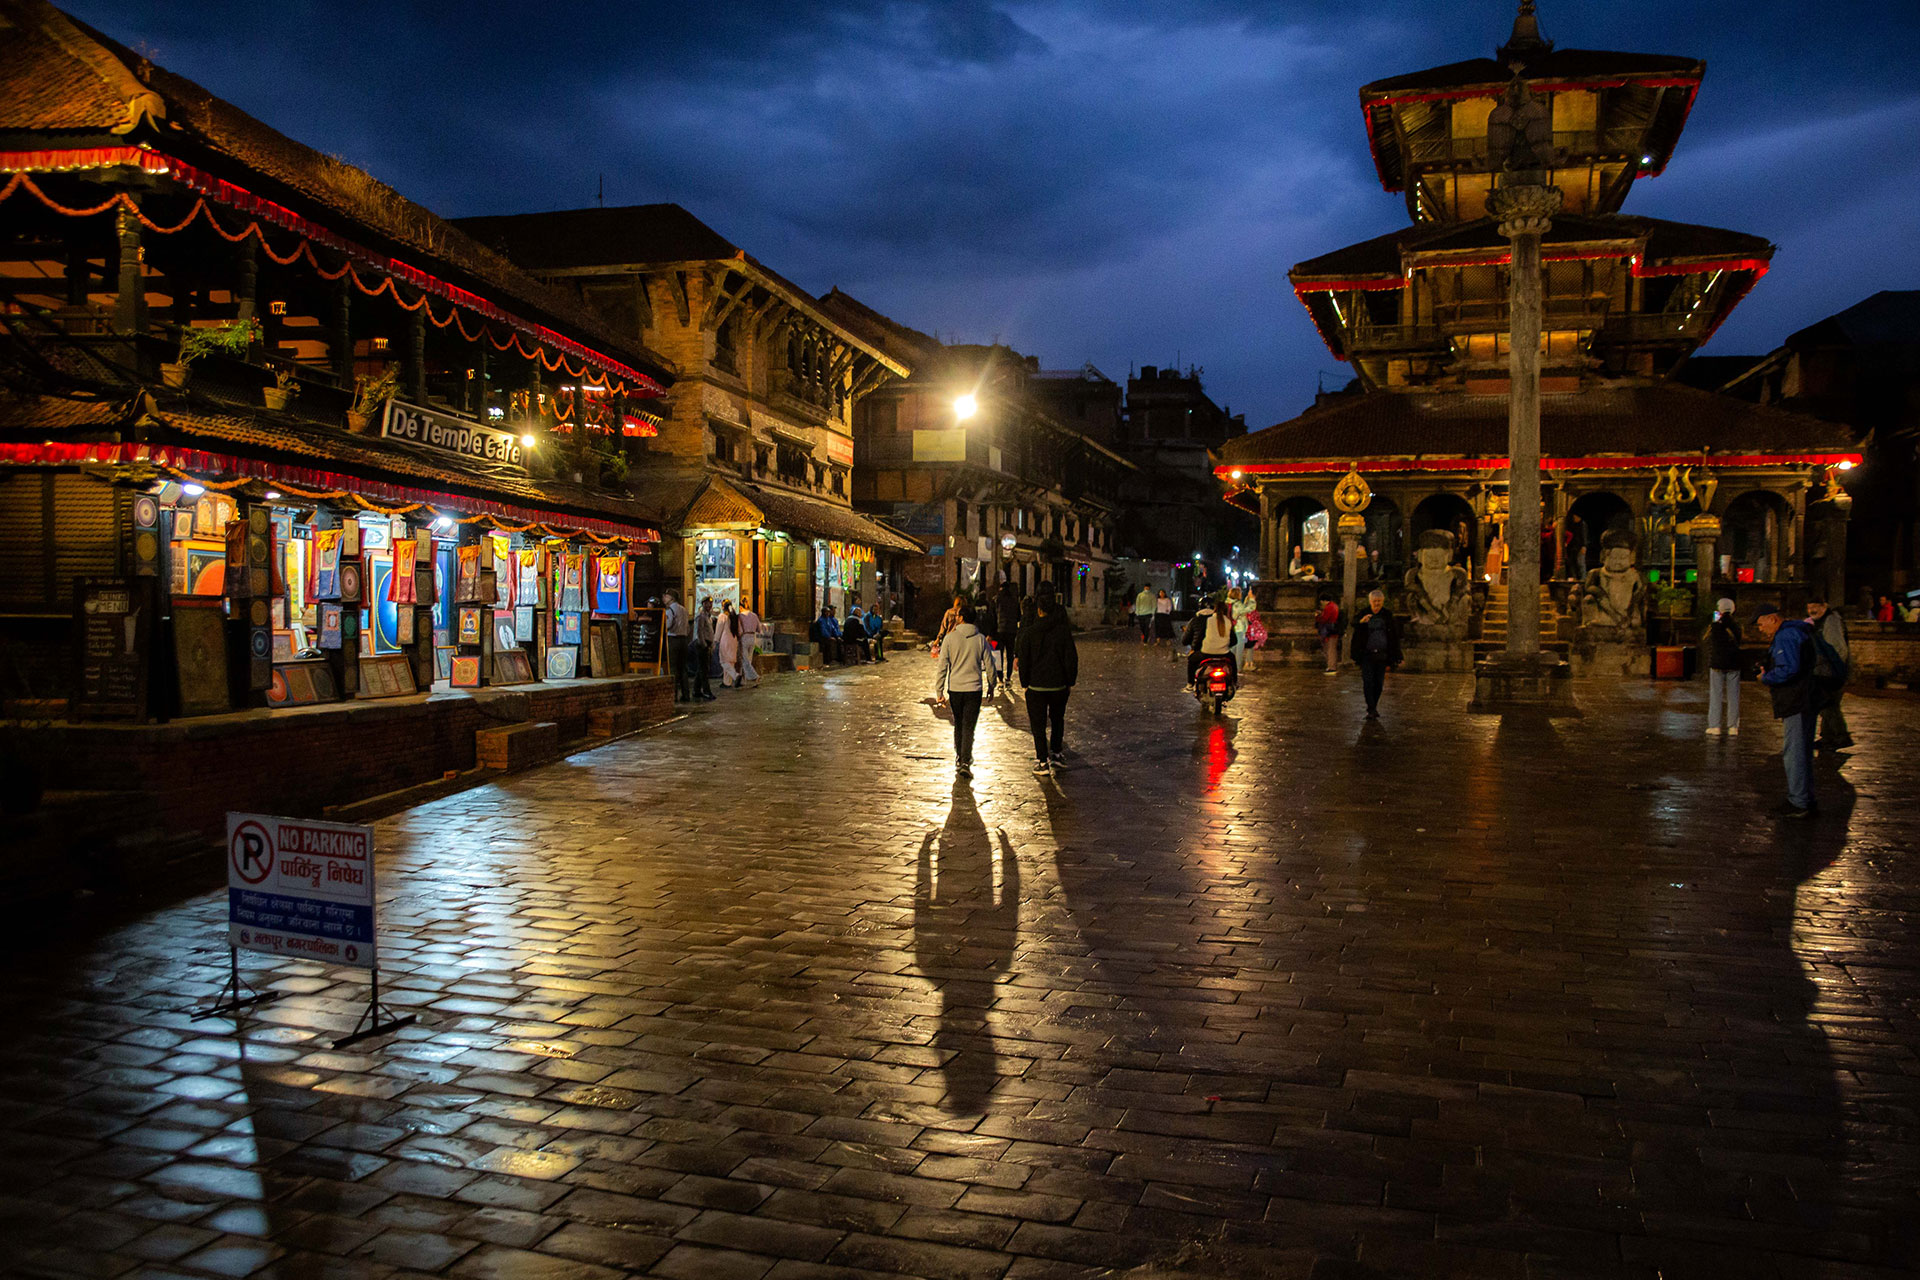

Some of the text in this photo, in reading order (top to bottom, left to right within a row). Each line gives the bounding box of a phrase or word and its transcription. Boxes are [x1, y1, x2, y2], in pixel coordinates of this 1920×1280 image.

[391, 407, 418, 438] Dé
[421, 415, 482, 454] Temple
[98, 602, 128, 611] MENU
[279, 827, 364, 858] NO PARKING
[327, 860, 364, 885] निषेध
[287, 937, 340, 956] नगरपालिका
